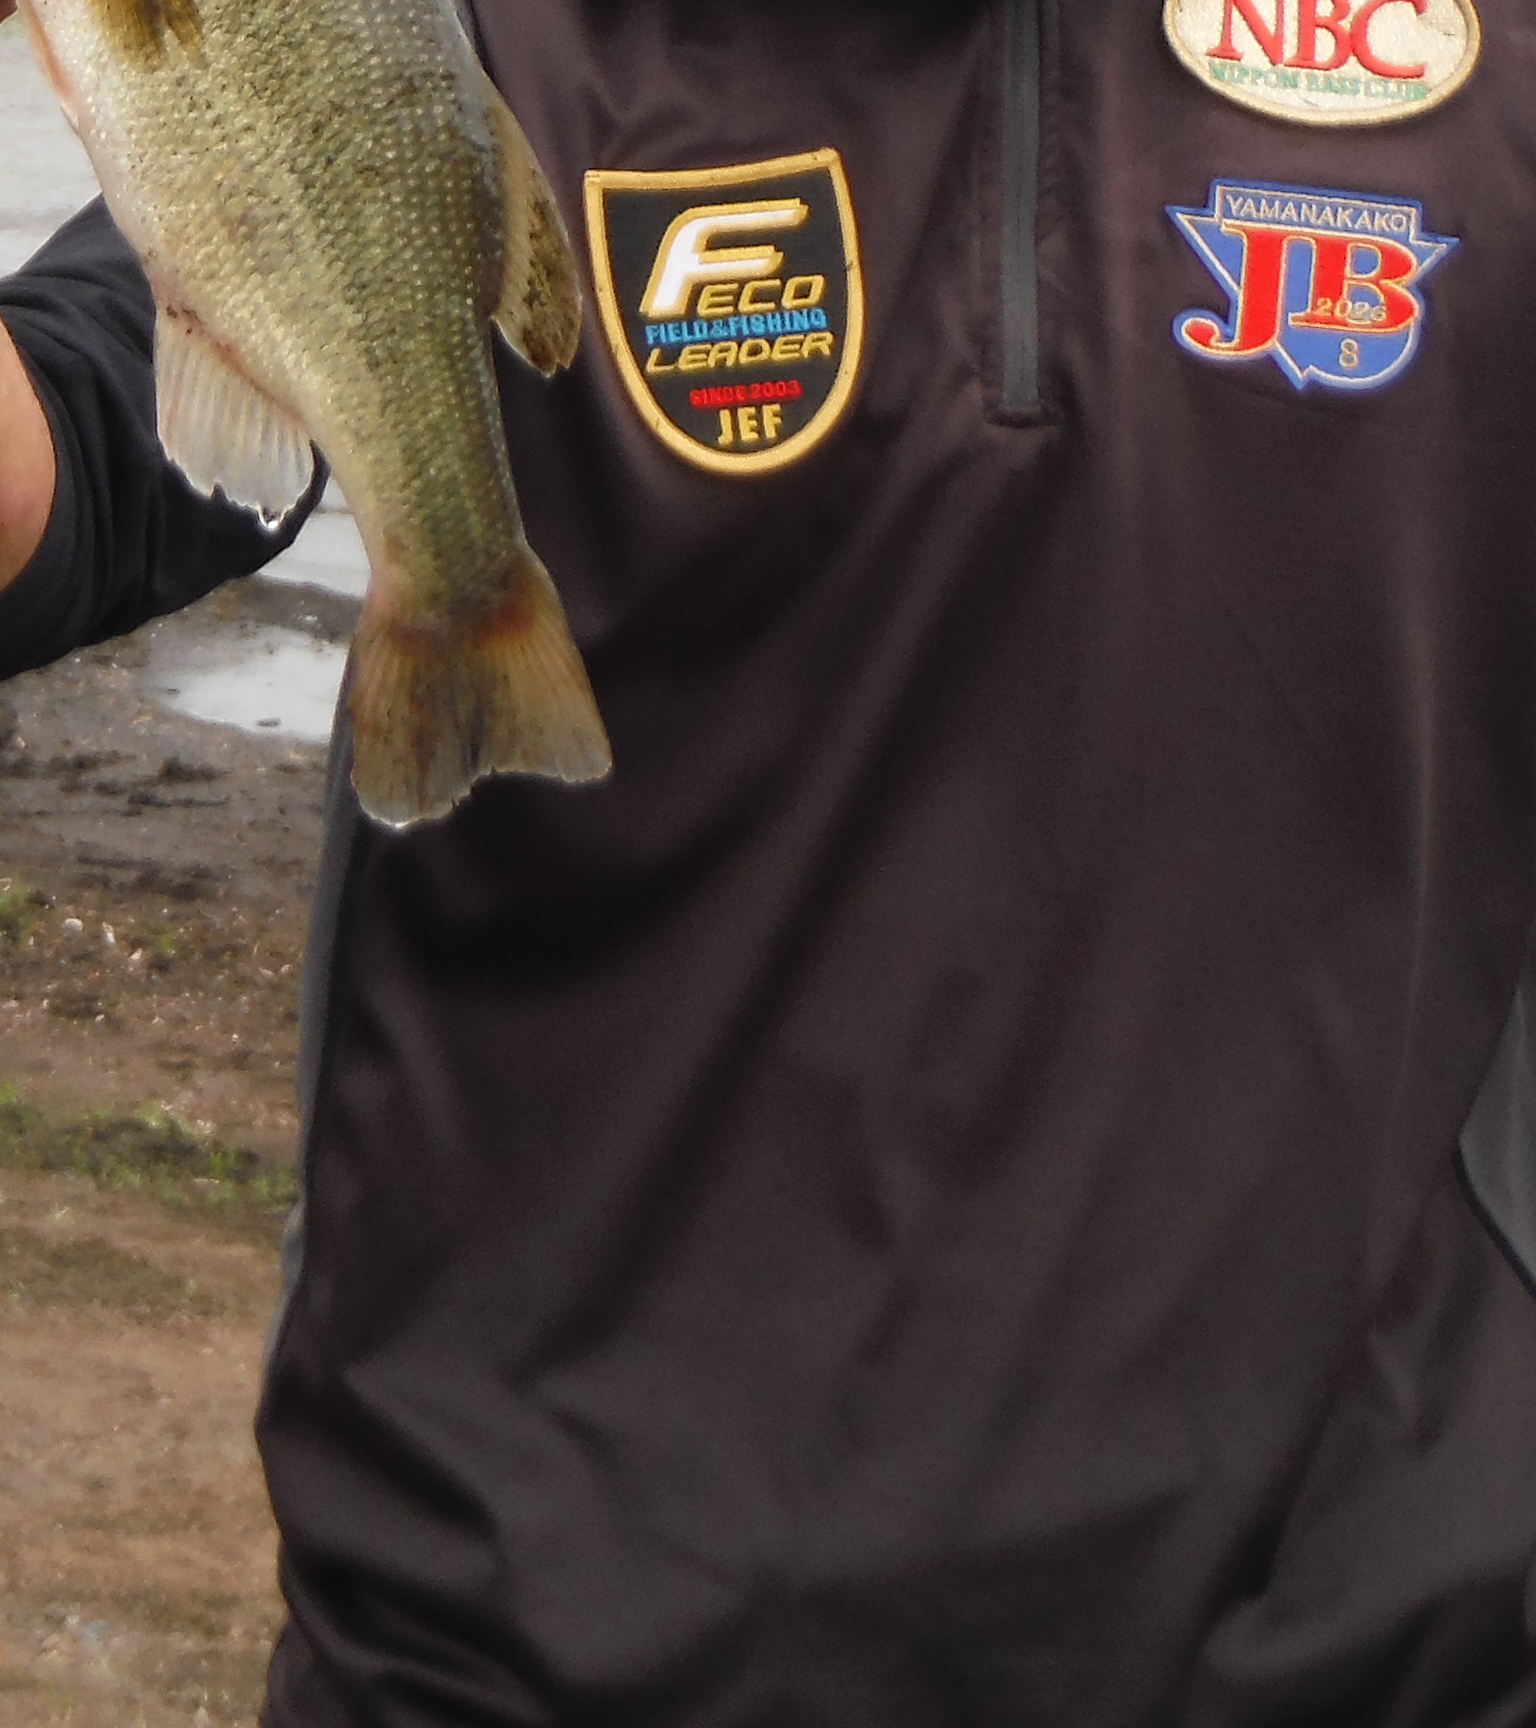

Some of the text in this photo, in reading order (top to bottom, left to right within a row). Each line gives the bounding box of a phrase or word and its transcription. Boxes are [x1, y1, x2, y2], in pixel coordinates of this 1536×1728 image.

[1208, 61, 1298, 88] NIPPON
[1306, 71, 1361, 96] BASS
[1225, 194, 1408, 233] YAMANAKAKO
[1181, 219, 1420, 356] JB
[644, 308, 828, 345] FIELD&FISHING
[646, 331, 834, 373] LEADER
[1338, 338, 1359, 368] 8
[750, 380, 803, 402] 2003
[717, 403, 783, 445] JEF
